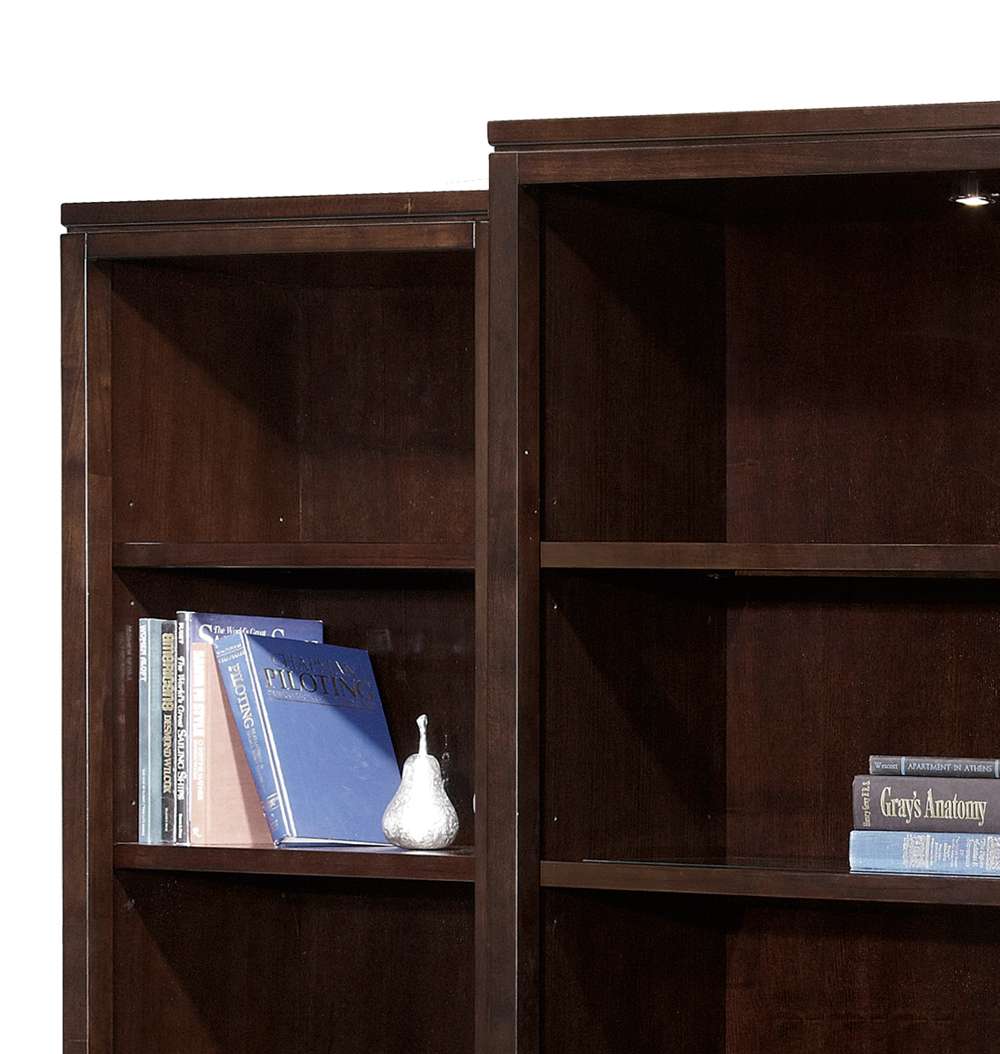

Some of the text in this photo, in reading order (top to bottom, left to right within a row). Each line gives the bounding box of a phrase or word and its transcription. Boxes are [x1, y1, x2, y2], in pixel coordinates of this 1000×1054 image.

[228, 662, 254, 728] PILOTING
[163, 714, 172, 794] DESMOND WILCOX
[178, 729, 188, 800] SAILING SHIPS
[908, 762, 993, 772] APARTMENT IN ATHENS
[880, 786, 922, 824] Gray's
[924, 788, 987, 826] Anatomy
